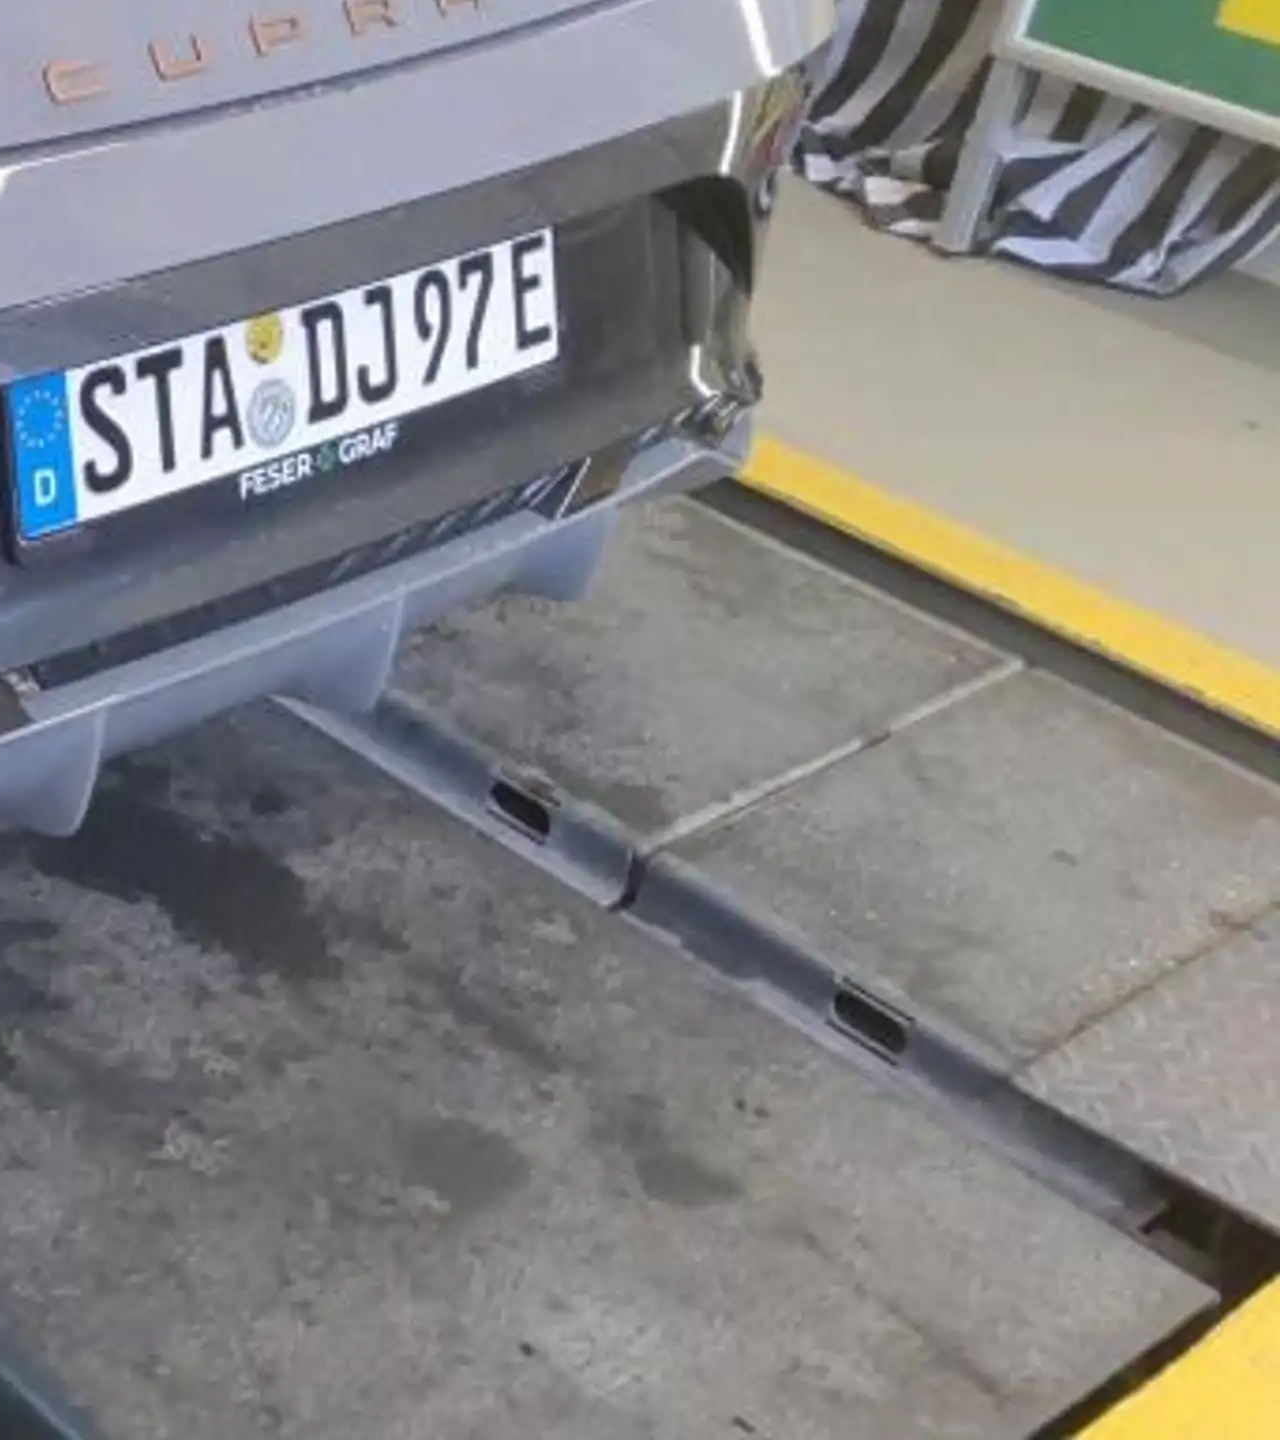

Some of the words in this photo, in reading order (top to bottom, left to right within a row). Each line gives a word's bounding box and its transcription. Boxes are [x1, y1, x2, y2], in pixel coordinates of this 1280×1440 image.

[79, 333, 245, 495] STA
[33, 468, 57, 507] D
[238, 452, 314, 501] FESER
[338, 420, 398, 464] GRAF
